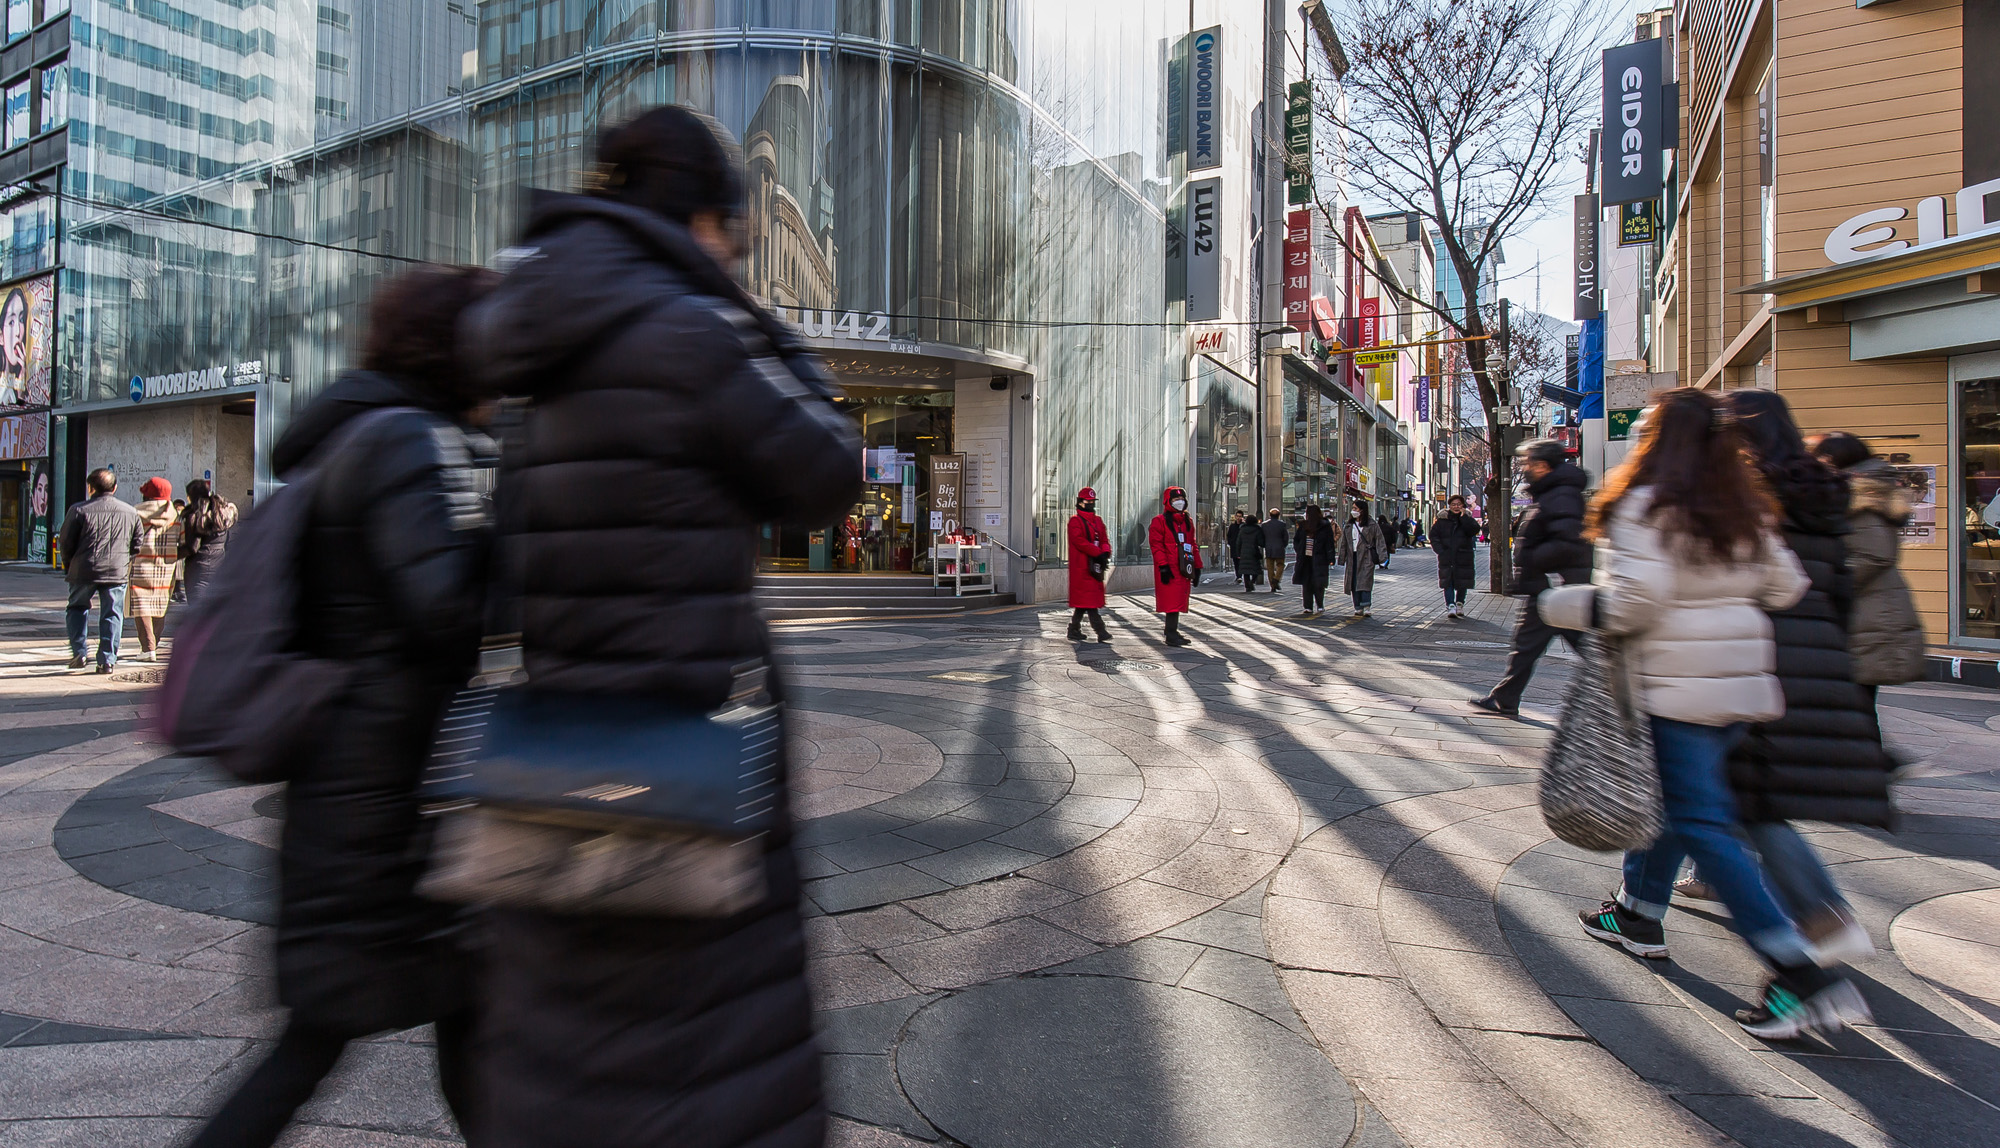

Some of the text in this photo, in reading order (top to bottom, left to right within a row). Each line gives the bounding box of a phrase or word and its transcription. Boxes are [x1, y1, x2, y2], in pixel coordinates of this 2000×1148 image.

[1197, 52, 1212, 107] WOORI
[1621, 66, 1643, 178] EIDER
[1197, 110, 1211, 158] BANK
[1194, 186, 1213, 256] LU42
[1625, 216, 1649, 228] 서민호
[1625, 225, 1650, 235] 미용실
[1288, 228, 1309, 315] 금강제화
[1578, 259, 1594, 299] AHC
[1195, 331, 1224, 351] H&M
[1568, 335, 1579, 343] AB
[890, 343, 921, 355] 루사십이
[1356, 354, 1374, 363] CCTV
[233, 360, 261, 376] 우리은행
[145, 372, 187, 398] WOORI
[187, 365, 228, 393] BANK
[935, 462, 959, 470] LU42
[939, 484, 955, 498] Big
[936, 498, 957, 508] Sale
